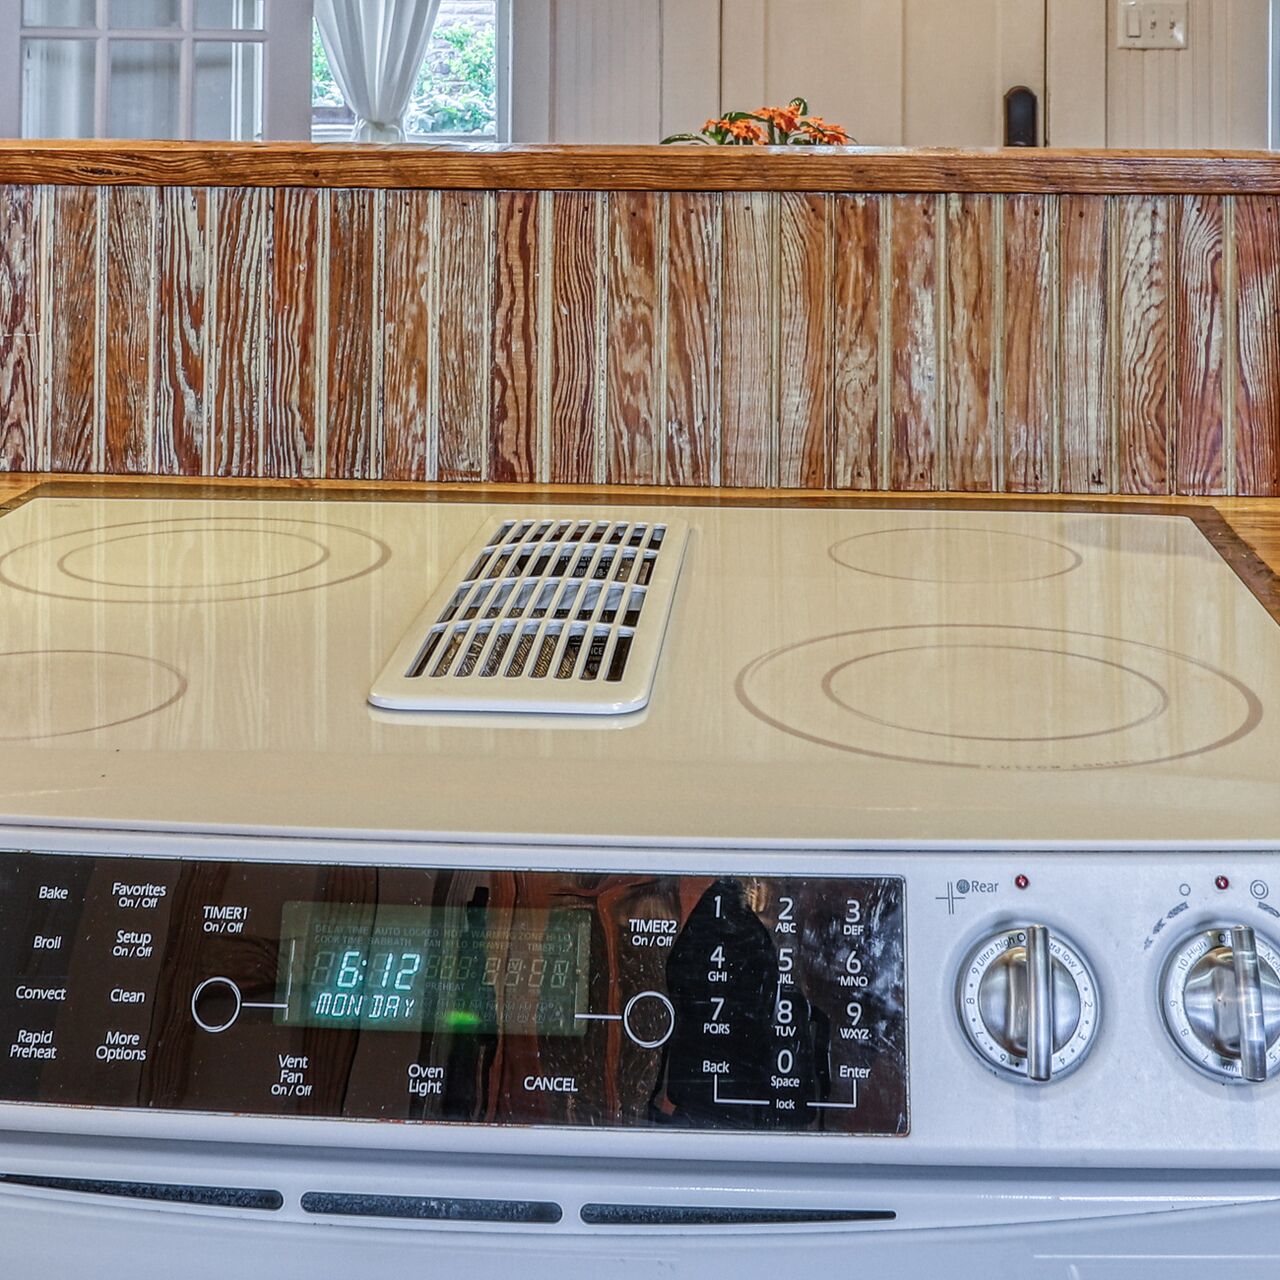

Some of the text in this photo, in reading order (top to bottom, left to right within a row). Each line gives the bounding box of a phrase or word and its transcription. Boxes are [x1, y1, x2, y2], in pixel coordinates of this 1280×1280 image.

[38, 885, 69, 900] Bake
[112, 882, 167, 897] Favorites
[971, 880, 999, 893] Rear
[142, 897, 159, 909] Off
[714, 895, 722, 919] 1
[778, 897, 794, 920] 2
[203, 905, 248, 920] TIMER1
[845, 899, 861, 923] 3
[227, 922, 244, 933] Off
[629, 919, 677, 934] TIMER2
[775, 922, 797, 934] ABC
[843, 924, 865, 936] DEF
[33, 935, 62, 950] Broil
[116, 930, 152, 947] Setup
[656, 936, 673, 947] Off
[136, 946, 153, 957] Off
[710, 945, 726, 969] 4
[978, 947, 996, 967] Ultra
[995, 935, 1015, 952] high
[1177, 940, 1208, 972] 10 High
[778, 948, 794, 971] 5
[846, 950, 862, 974] 6
[1062, 950, 1078, 968] low
[337, 951, 421, 991] 6:12
[707, 971, 728, 983] GHI
[972, 967, 980, 976] 9
[777, 973, 795, 985] JKL
[840, 975, 869, 987] MNO
[15, 985, 67, 1001] Convect
[110, 988, 146, 1003] Clean
[966, 997, 976, 1005] 8
[1084, 1000, 1093, 1008] 2
[710, 997, 725, 1021] 7
[777, 999, 793, 1024] 8
[846, 1002, 863, 1026] 9
[703, 1023, 731, 1035] PQRS
[775, 1025, 797, 1038] TUV
[840, 1028, 870, 1040] WXYZ
[1077, 1032, 1087, 1041] 3
[17, 1029, 54, 1048] Rapid
[105, 1031, 140, 1045] More
[10, 1044, 58, 1059] Preheat
[96, 1046, 147, 1063] Options
[278, 1054, 309, 1069] Vent
[702, 1060, 730, 1074] Back
[280, 1070, 304, 1084] Fan
[408, 1063, 444, 1079] Oven
[839, 1065, 871, 1079] Enter
[408, 1079, 442, 1097] Light
[524, 1076, 579, 1092] CANCEL
[770, 1075, 800, 1089] Space
[296, 1084, 313, 1096] Off
[776, 1098, 795, 1110] lock
